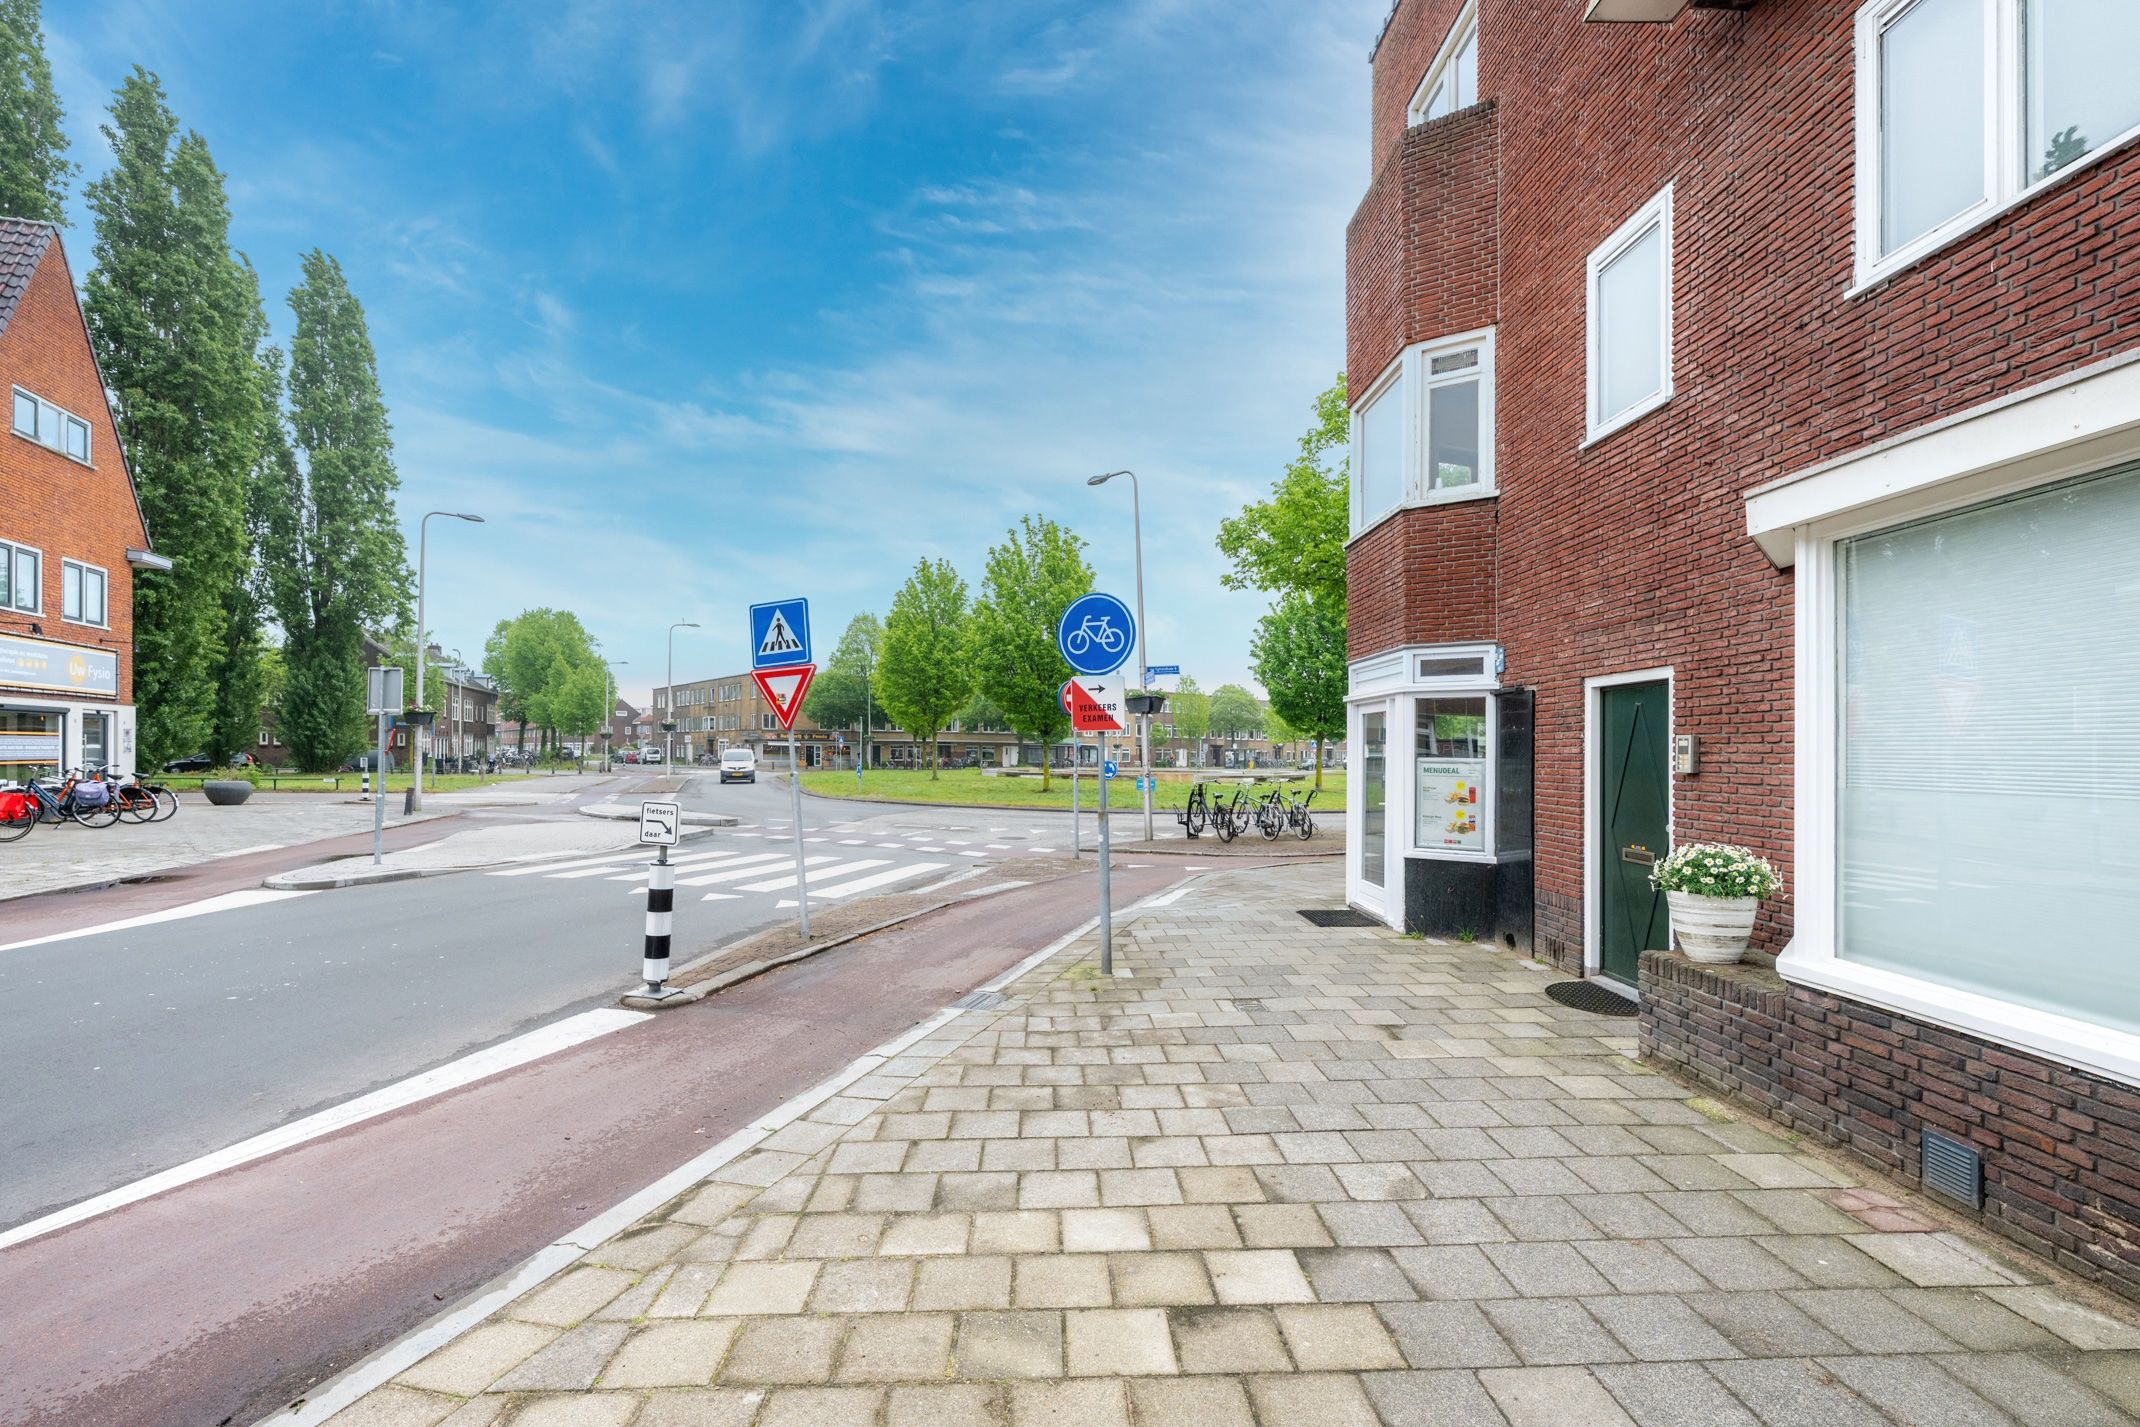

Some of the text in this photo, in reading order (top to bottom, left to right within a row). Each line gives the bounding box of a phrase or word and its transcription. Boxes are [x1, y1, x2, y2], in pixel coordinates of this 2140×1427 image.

[70, 663, 111, 680] Uw Fysio
[1079, 703, 1117, 712] VERKEERS
[1082, 714, 1114, 722] EXAMEN
